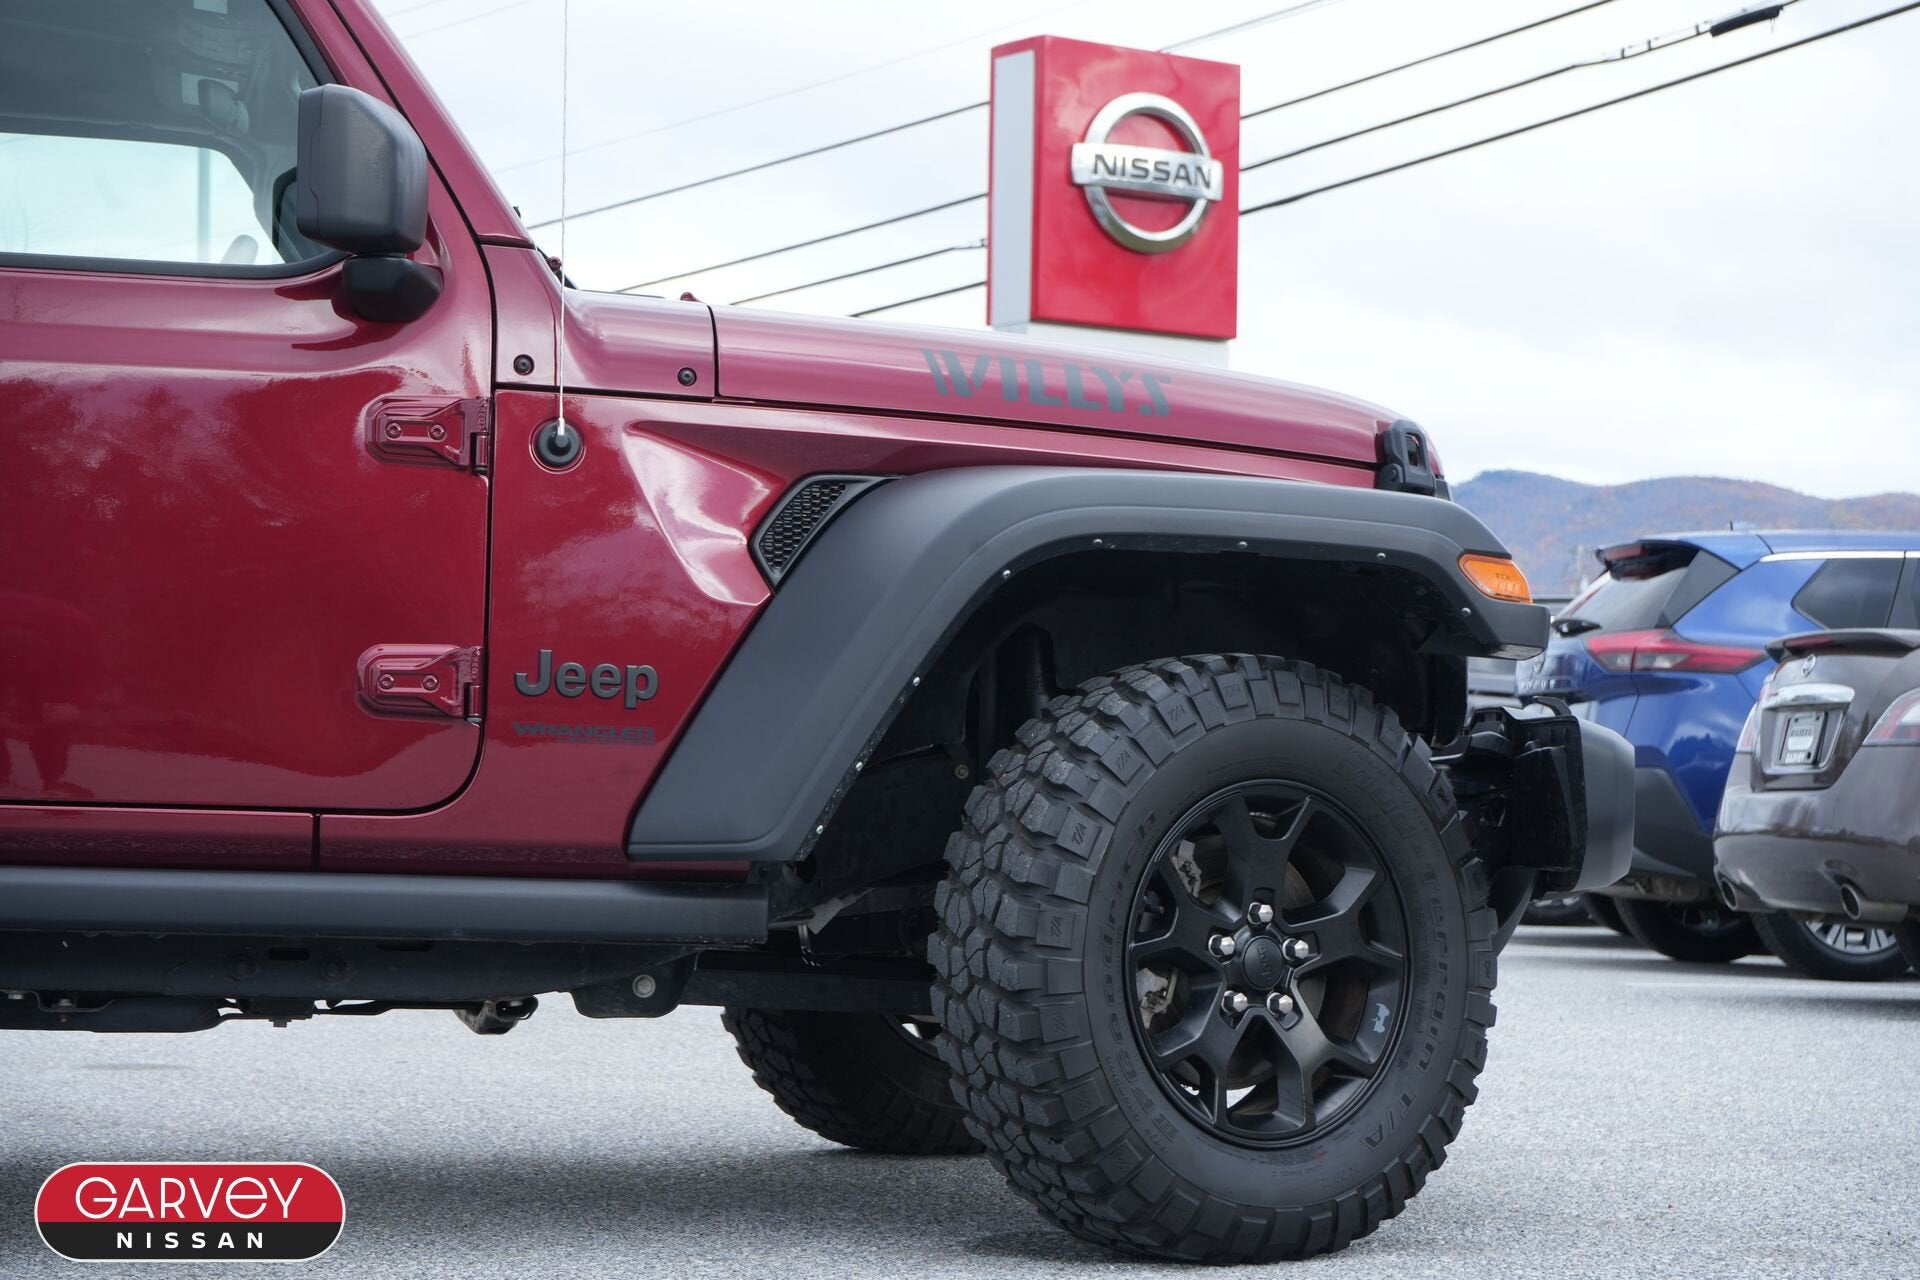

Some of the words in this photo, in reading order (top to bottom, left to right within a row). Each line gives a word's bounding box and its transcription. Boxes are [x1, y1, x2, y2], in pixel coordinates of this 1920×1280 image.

[1092, 153, 1212, 190] NISSAN
[922, 348, 1173, 417] WILLYS
[514, 649, 660, 711] Jeep
[511, 721, 656, 739] WRANGLER
[1360, 1088, 1417, 1152] T/A
